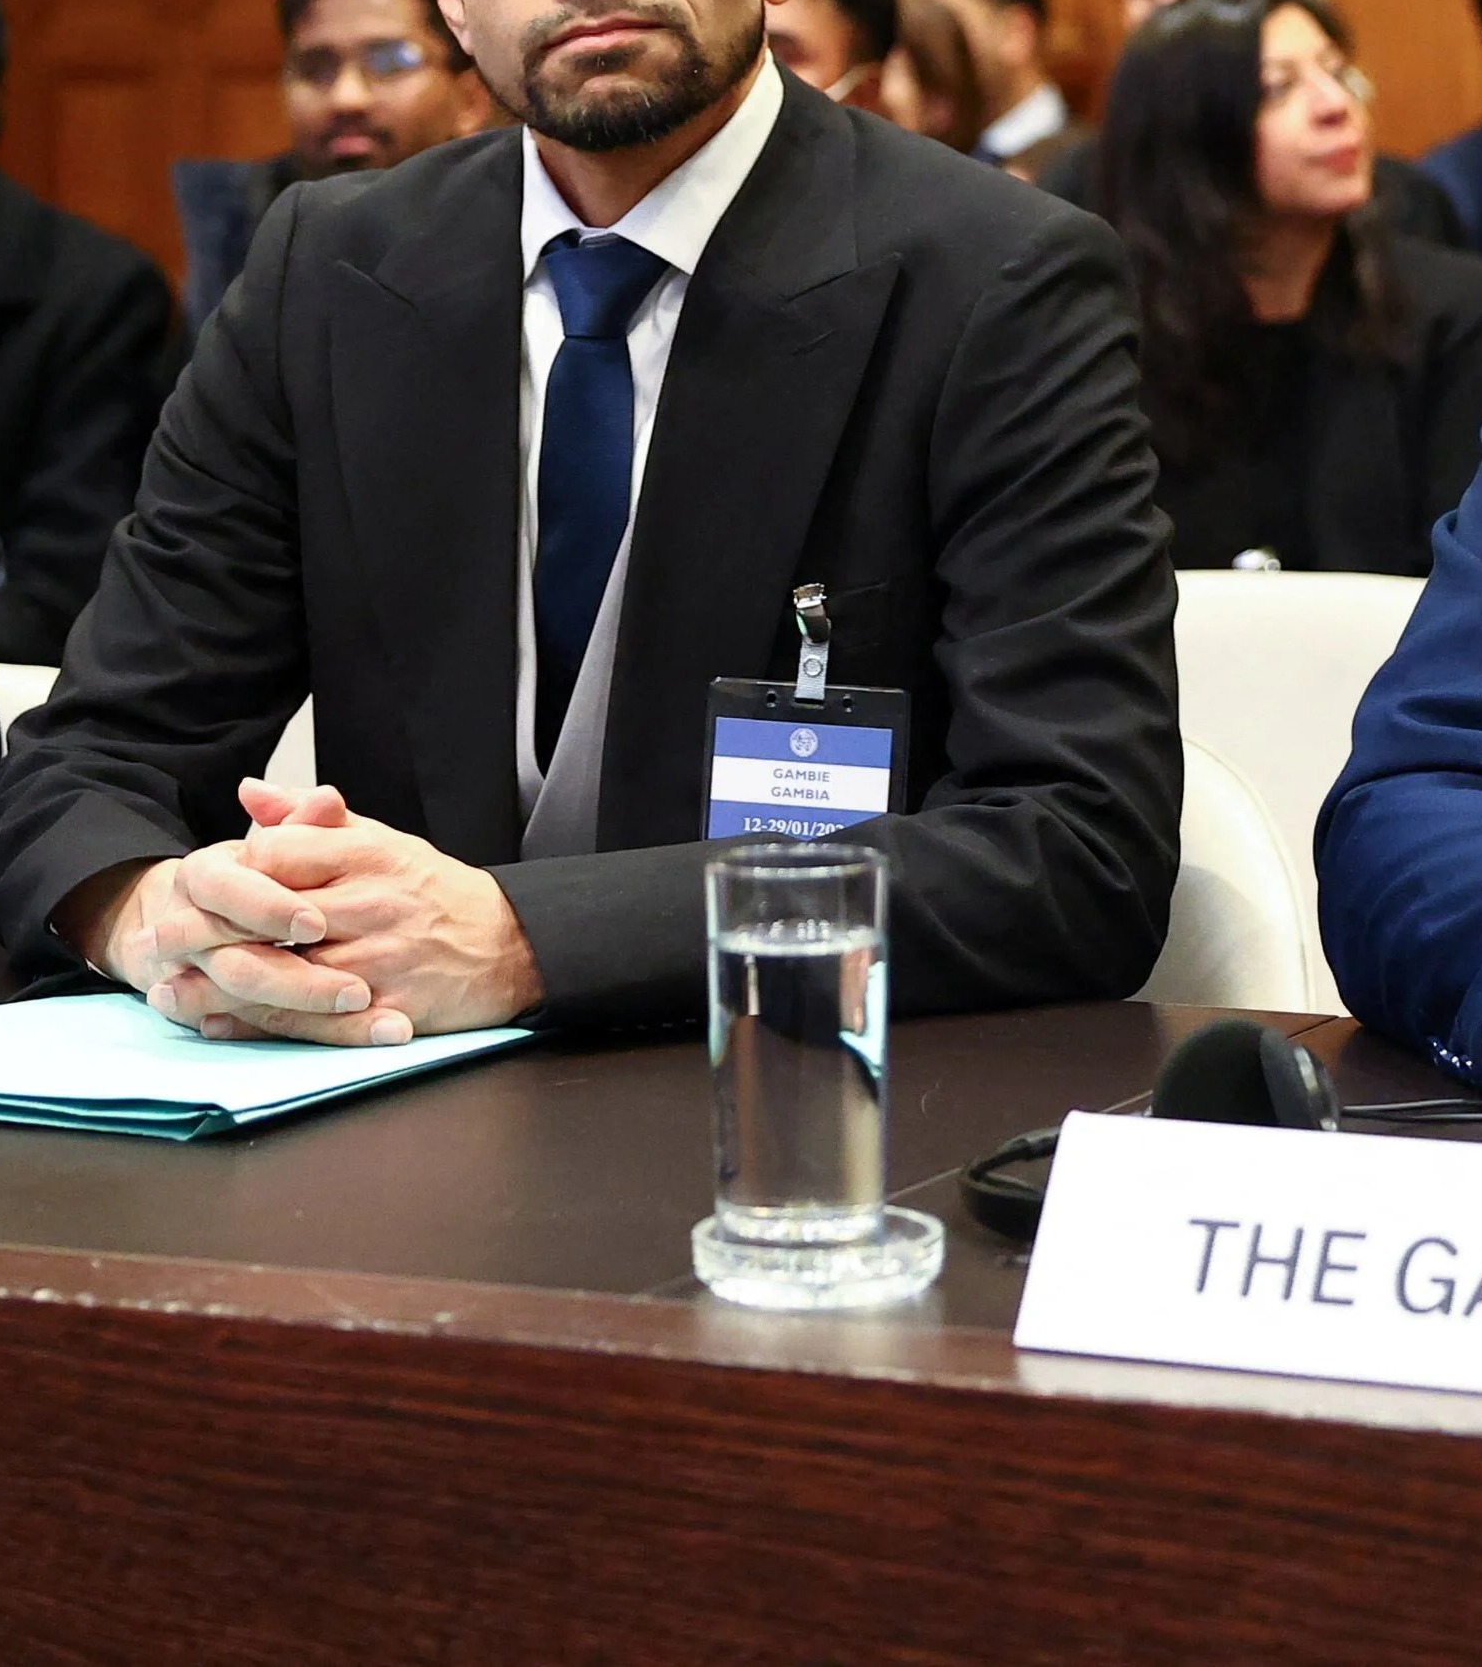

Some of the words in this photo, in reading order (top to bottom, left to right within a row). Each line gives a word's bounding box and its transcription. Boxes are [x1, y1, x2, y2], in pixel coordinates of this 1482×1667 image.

[772, 767, 831, 784] GAMBIE
[770, 786, 831, 802] GAMBIA
[1189, 1218, 1366, 1307] THE
